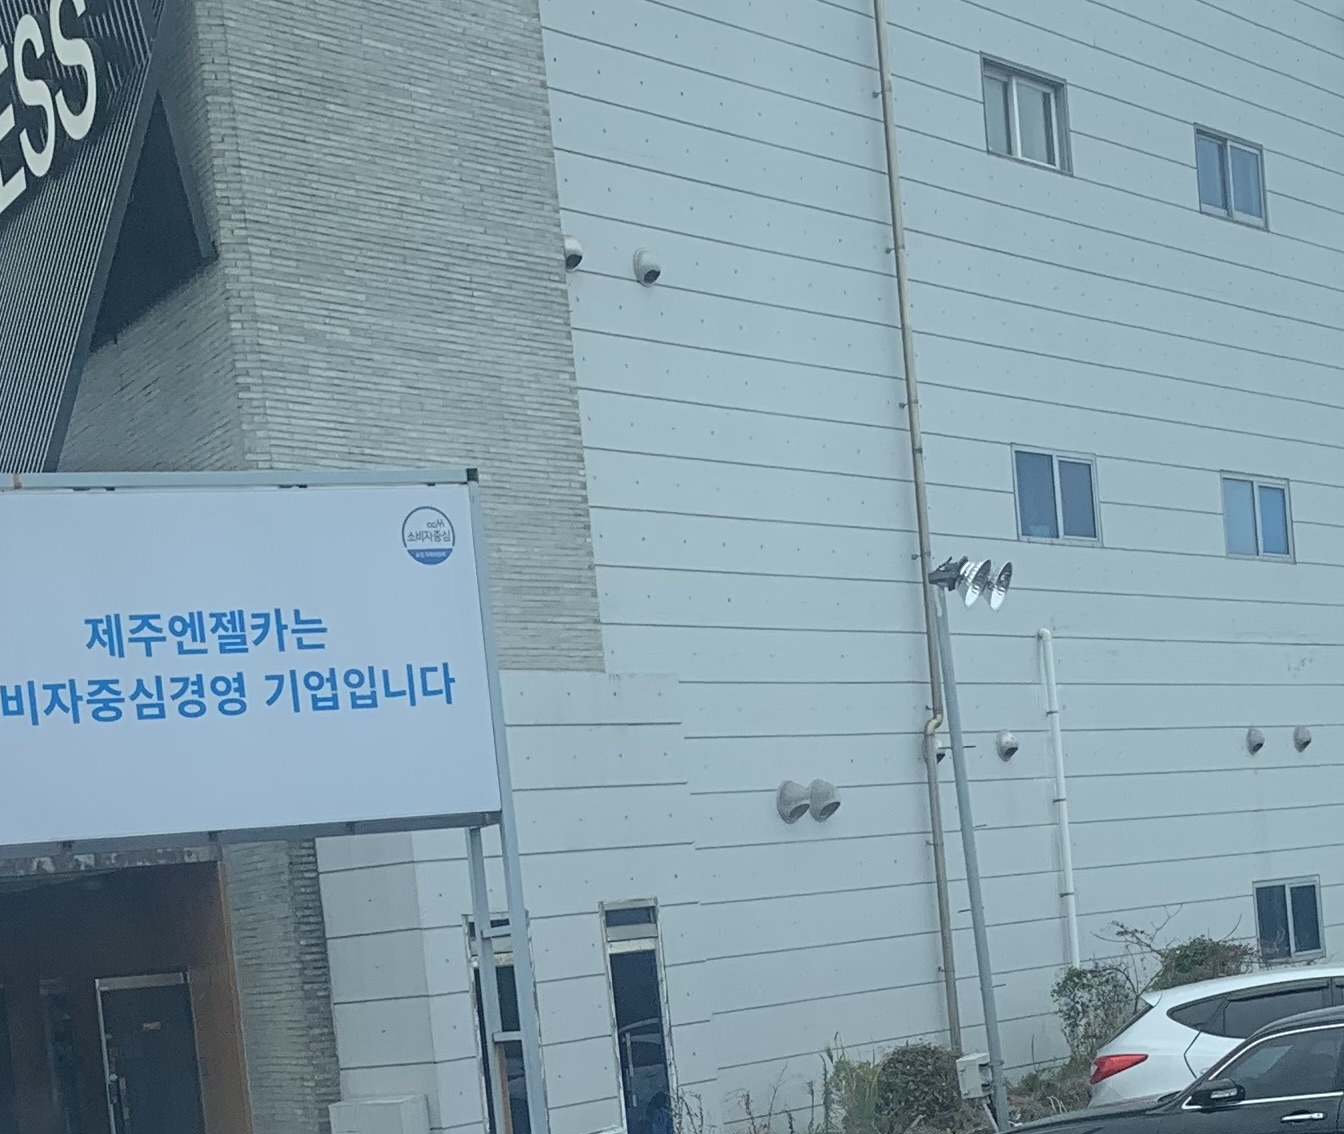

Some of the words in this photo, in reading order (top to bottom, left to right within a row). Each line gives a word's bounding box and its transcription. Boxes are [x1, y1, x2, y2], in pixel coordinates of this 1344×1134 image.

[407, 530, 451, 542] 소비자중심
[84, 608, 329, 658] 제주엔젤카는
[264, 661, 456, 713] 기업입니다
